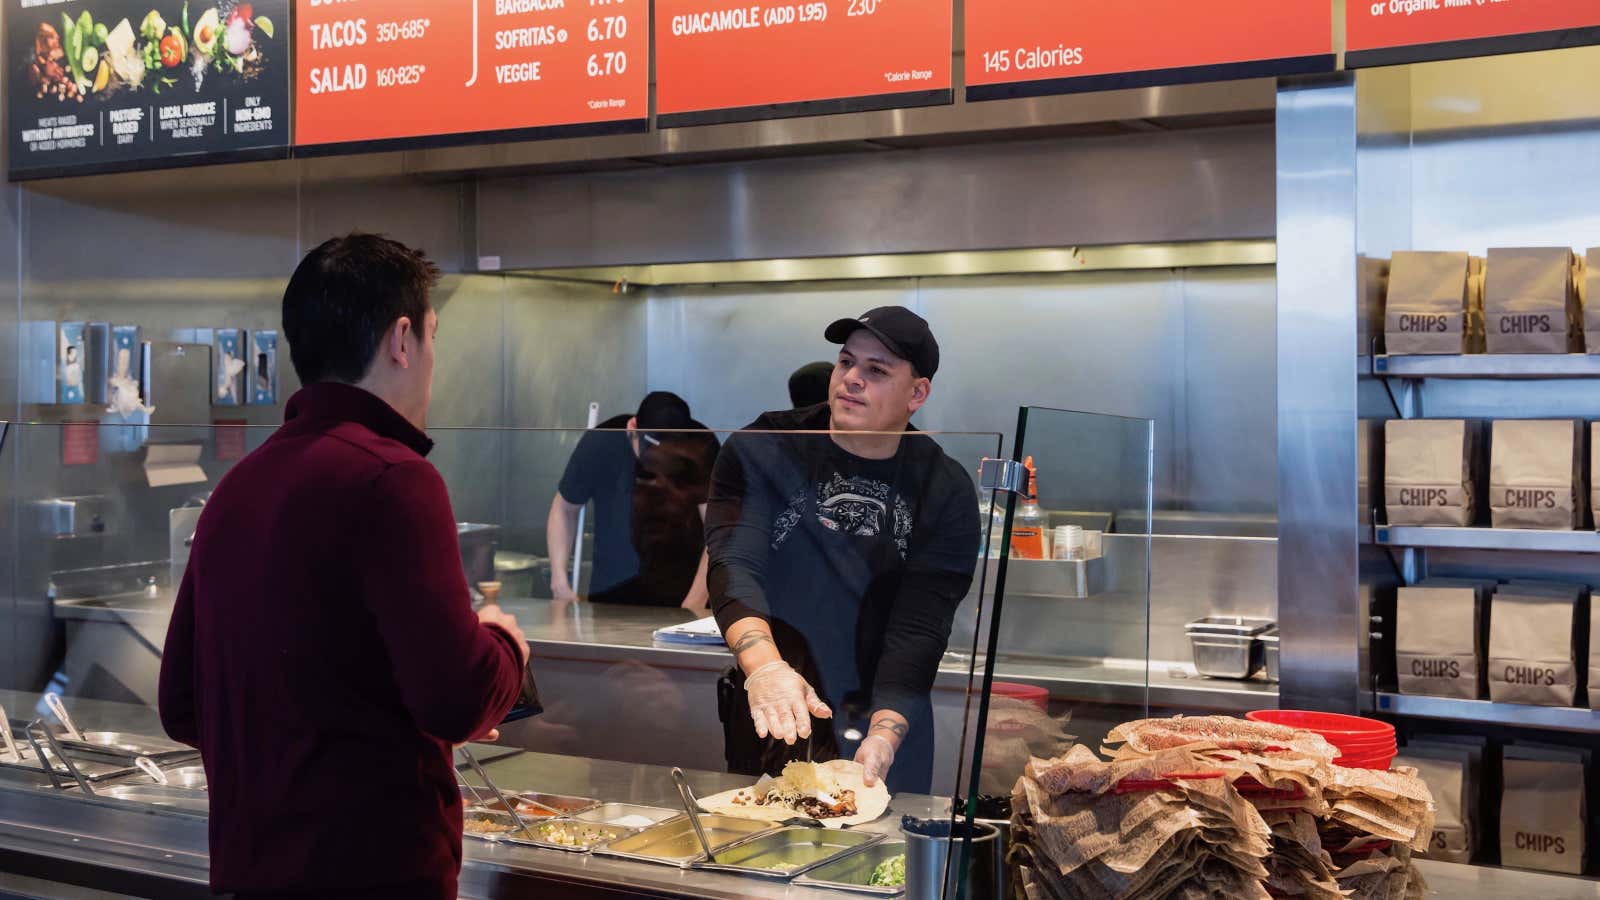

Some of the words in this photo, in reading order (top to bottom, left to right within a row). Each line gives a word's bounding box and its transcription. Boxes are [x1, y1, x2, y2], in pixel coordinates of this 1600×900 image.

[671, 6, 760, 36] GUACAMOLE
[763, 6, 795, 27] (ADD
[797, 2, 828, 22] 1.95)
[847, 0, 881, 17] 230
[1370, 3, 1386, 17] or
[1389, 0, 1440, 16] Organic
[309, 18, 367, 50] TACOS
[495, 25, 555, 50] SOFRITAS
[587, 15, 627, 42] 6.70
[586, 51, 627, 77] 6.70
[983, 49, 1010, 73] 145
[1014, 43, 1083, 71] Calories
[309, 63, 367, 94] SALAD
[495, 61, 542, 84] VEGGIE
[911, 69, 933, 80] Range
[1399, 314, 1448, 333] CHIPS
[1500, 314, 1551, 334] CHIPS
[1400, 488, 1448, 506] CHIPS
[1505, 489, 1556, 509] CHIPS
[1411, 659, 1460, 679] CHIPS
[1504, 665, 1555, 686] CHIPS
[1515, 831, 1565, 855] CHIPS
